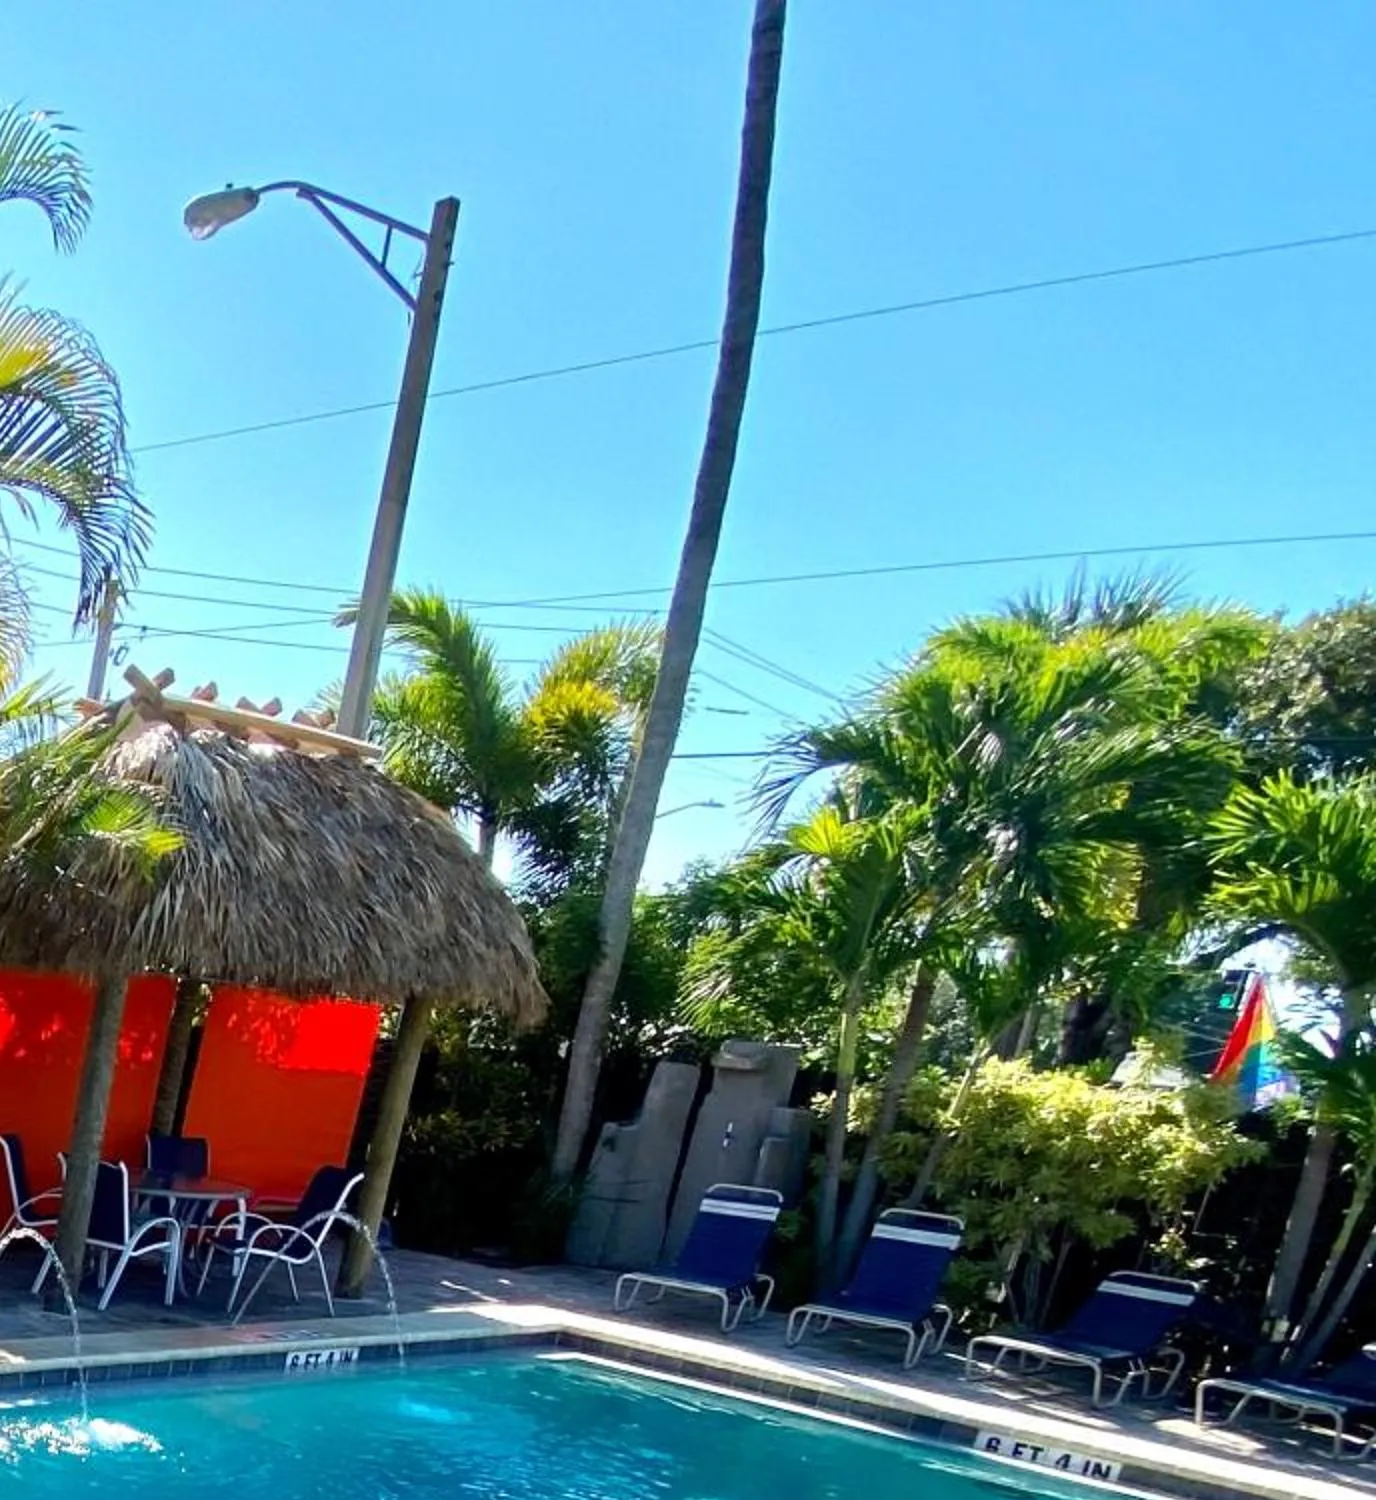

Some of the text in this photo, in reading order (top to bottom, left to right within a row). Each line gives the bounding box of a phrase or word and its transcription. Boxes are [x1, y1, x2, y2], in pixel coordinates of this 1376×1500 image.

[305, 1353, 322, 1367] FT
[339, 1350, 354, 1363] IN
[985, 1437, 1112, 1479] 6 FT 4 IN
